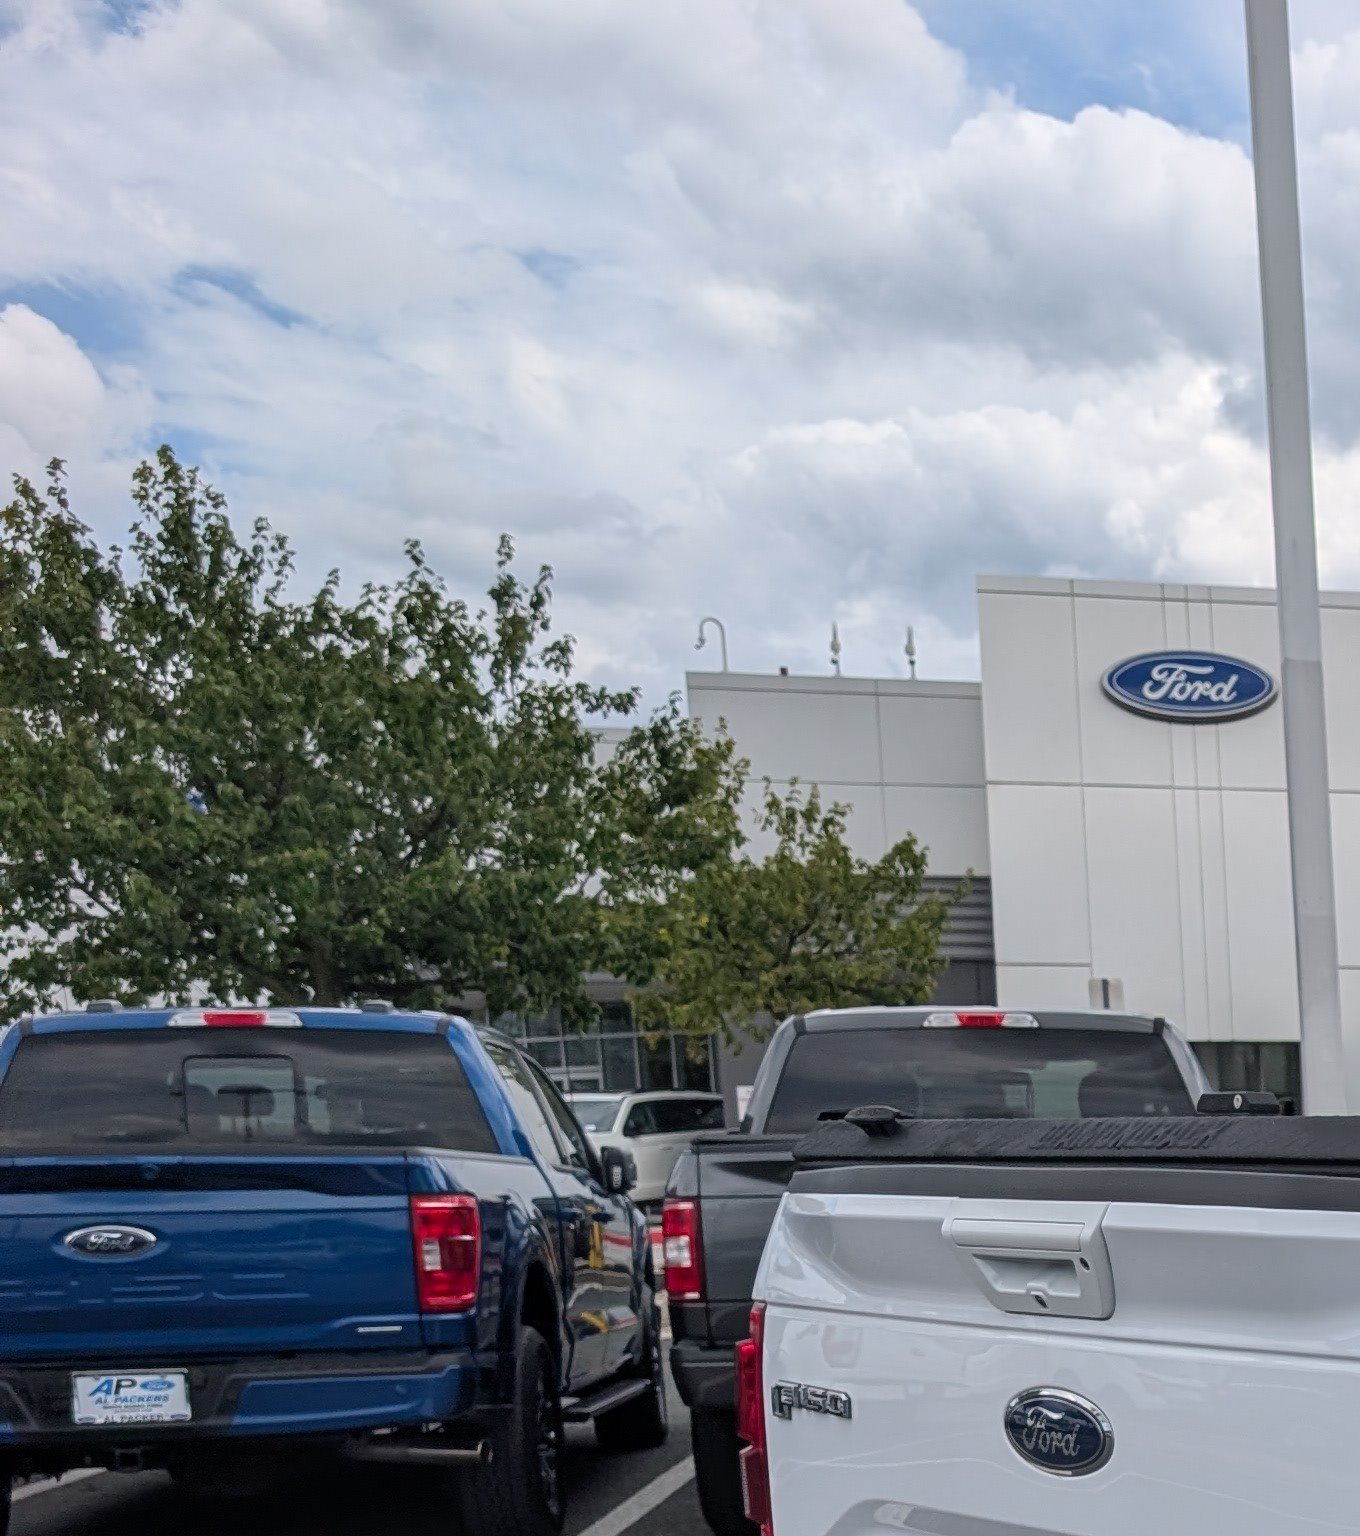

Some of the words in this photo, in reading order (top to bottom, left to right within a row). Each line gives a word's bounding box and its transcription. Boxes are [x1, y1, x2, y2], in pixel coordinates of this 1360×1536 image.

[1142, 663, 1238, 702] Ford
[87, 1232, 134, 1250] Ford
[88, 1379, 137, 1397] AP
[1023, 1406, 1080, 1456] Ford
